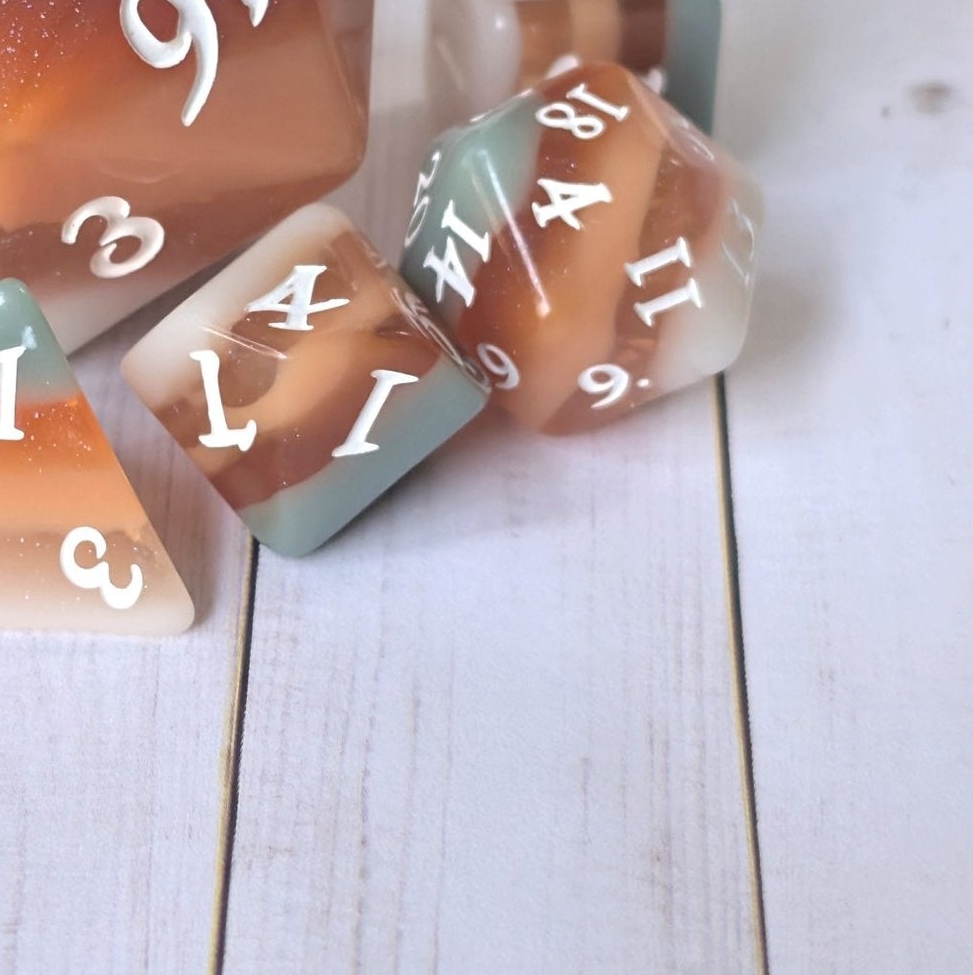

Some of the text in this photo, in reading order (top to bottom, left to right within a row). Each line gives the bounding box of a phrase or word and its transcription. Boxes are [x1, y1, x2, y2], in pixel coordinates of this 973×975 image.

[535, 83, 630, 140] 18
[61, 195, 165, 279] 3
[531, 178, 613, 231] 4
[423, 199, 492, 307] 14
[624, 236, 703, 326] 11
[244, 264, 351, 331] 4
[331, 369, 420, 457] 1
[59, 526, 144, 610] 3
